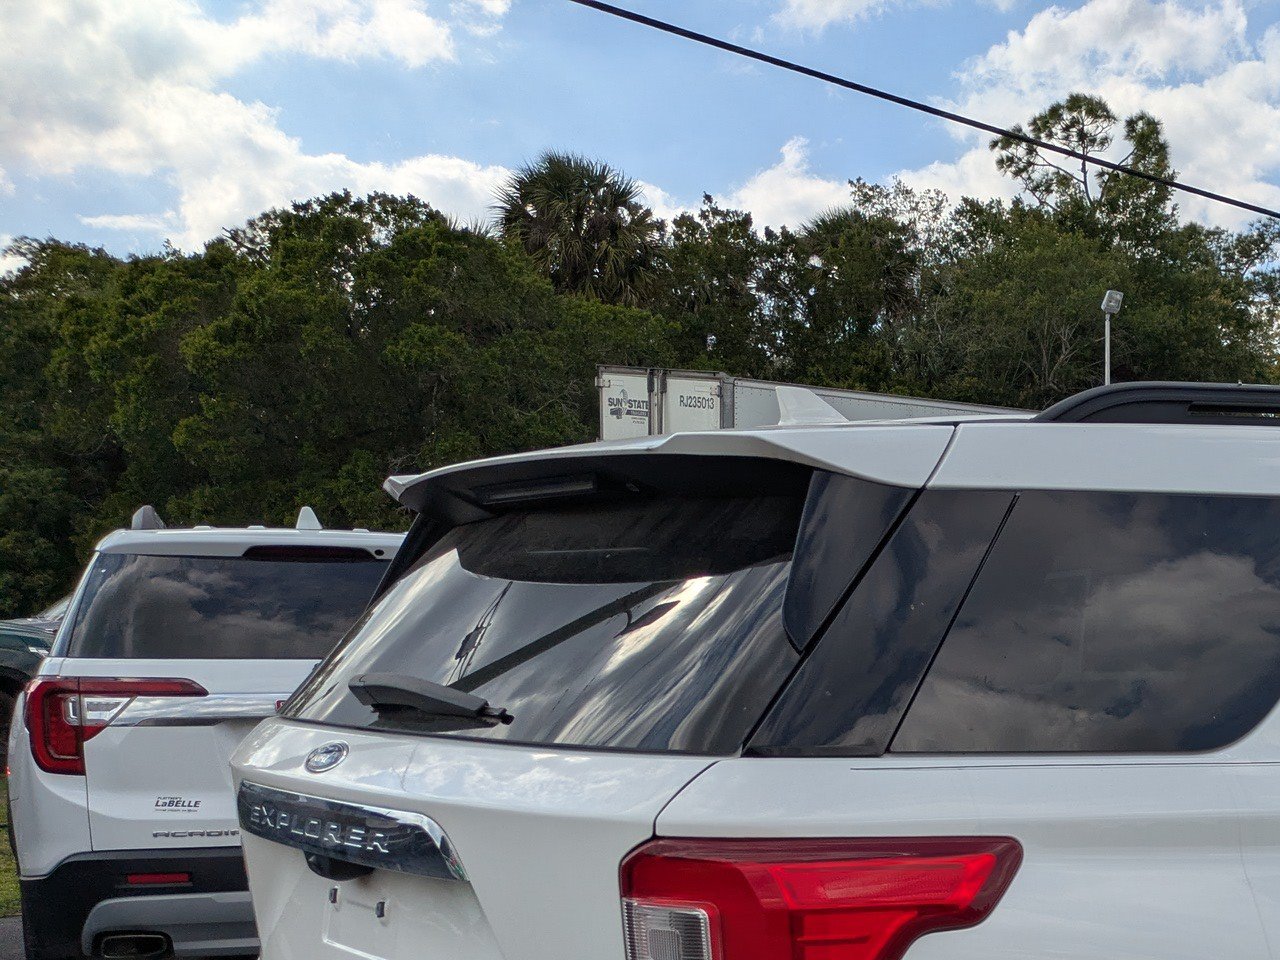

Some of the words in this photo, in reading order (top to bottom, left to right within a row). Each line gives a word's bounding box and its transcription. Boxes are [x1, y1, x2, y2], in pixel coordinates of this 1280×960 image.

[608, 397, 623, 407] SUN
[679, 395, 715, 410] RJ235013
[155, 800, 201, 808] LaBELLE
[249, 804, 390, 854] EXPLORER
